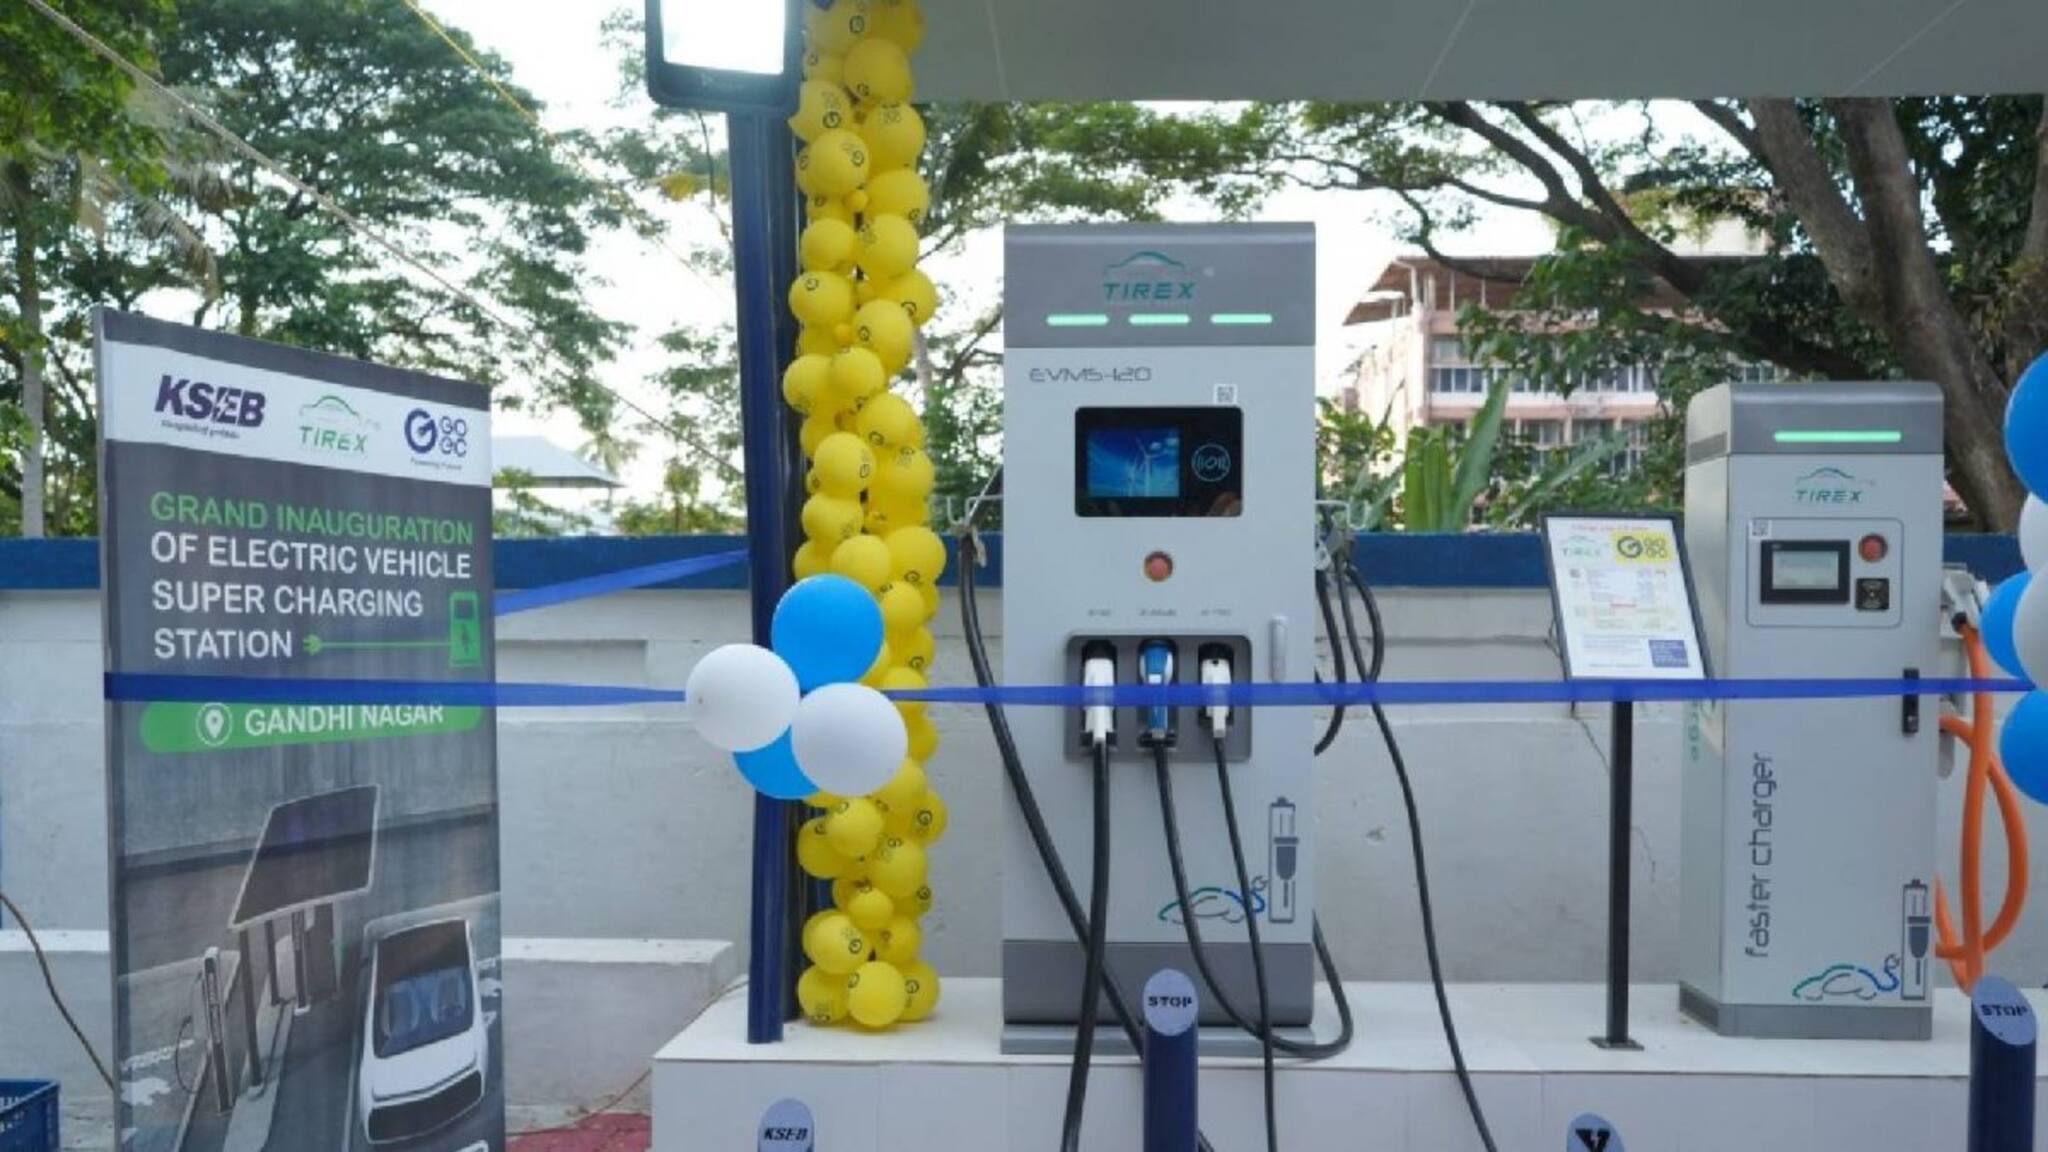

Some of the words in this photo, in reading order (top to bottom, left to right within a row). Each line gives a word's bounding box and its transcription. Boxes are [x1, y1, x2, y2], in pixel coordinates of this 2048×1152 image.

[1102, 281, 1197, 301] TIREX
[154, 374, 267, 428] KSEB
[299, 425, 368, 453] TIREX
[1795, 489, 1863, 503] TIREX
[150, 490, 268, 531] GRAND
[277, 504, 473, 545] INAUGURATION
[151, 530, 200, 564] OF
[208, 536, 357, 575] ELECTRIC
[364, 546, 472, 579] VEHICLE
[152, 578, 266, 615] SUPER
[274, 585, 424, 618] CHARGING
[154, 626, 293, 660] STATION
[245, 704, 352, 736] GANDHI
[360, 704, 444, 728] NAGAR
[1748, 751, 1777, 867] charger
[1744, 874, 1771, 958] faster
[1148, 996, 1193, 1008] STOP
[1980, 1004, 2028, 1017] STOP
